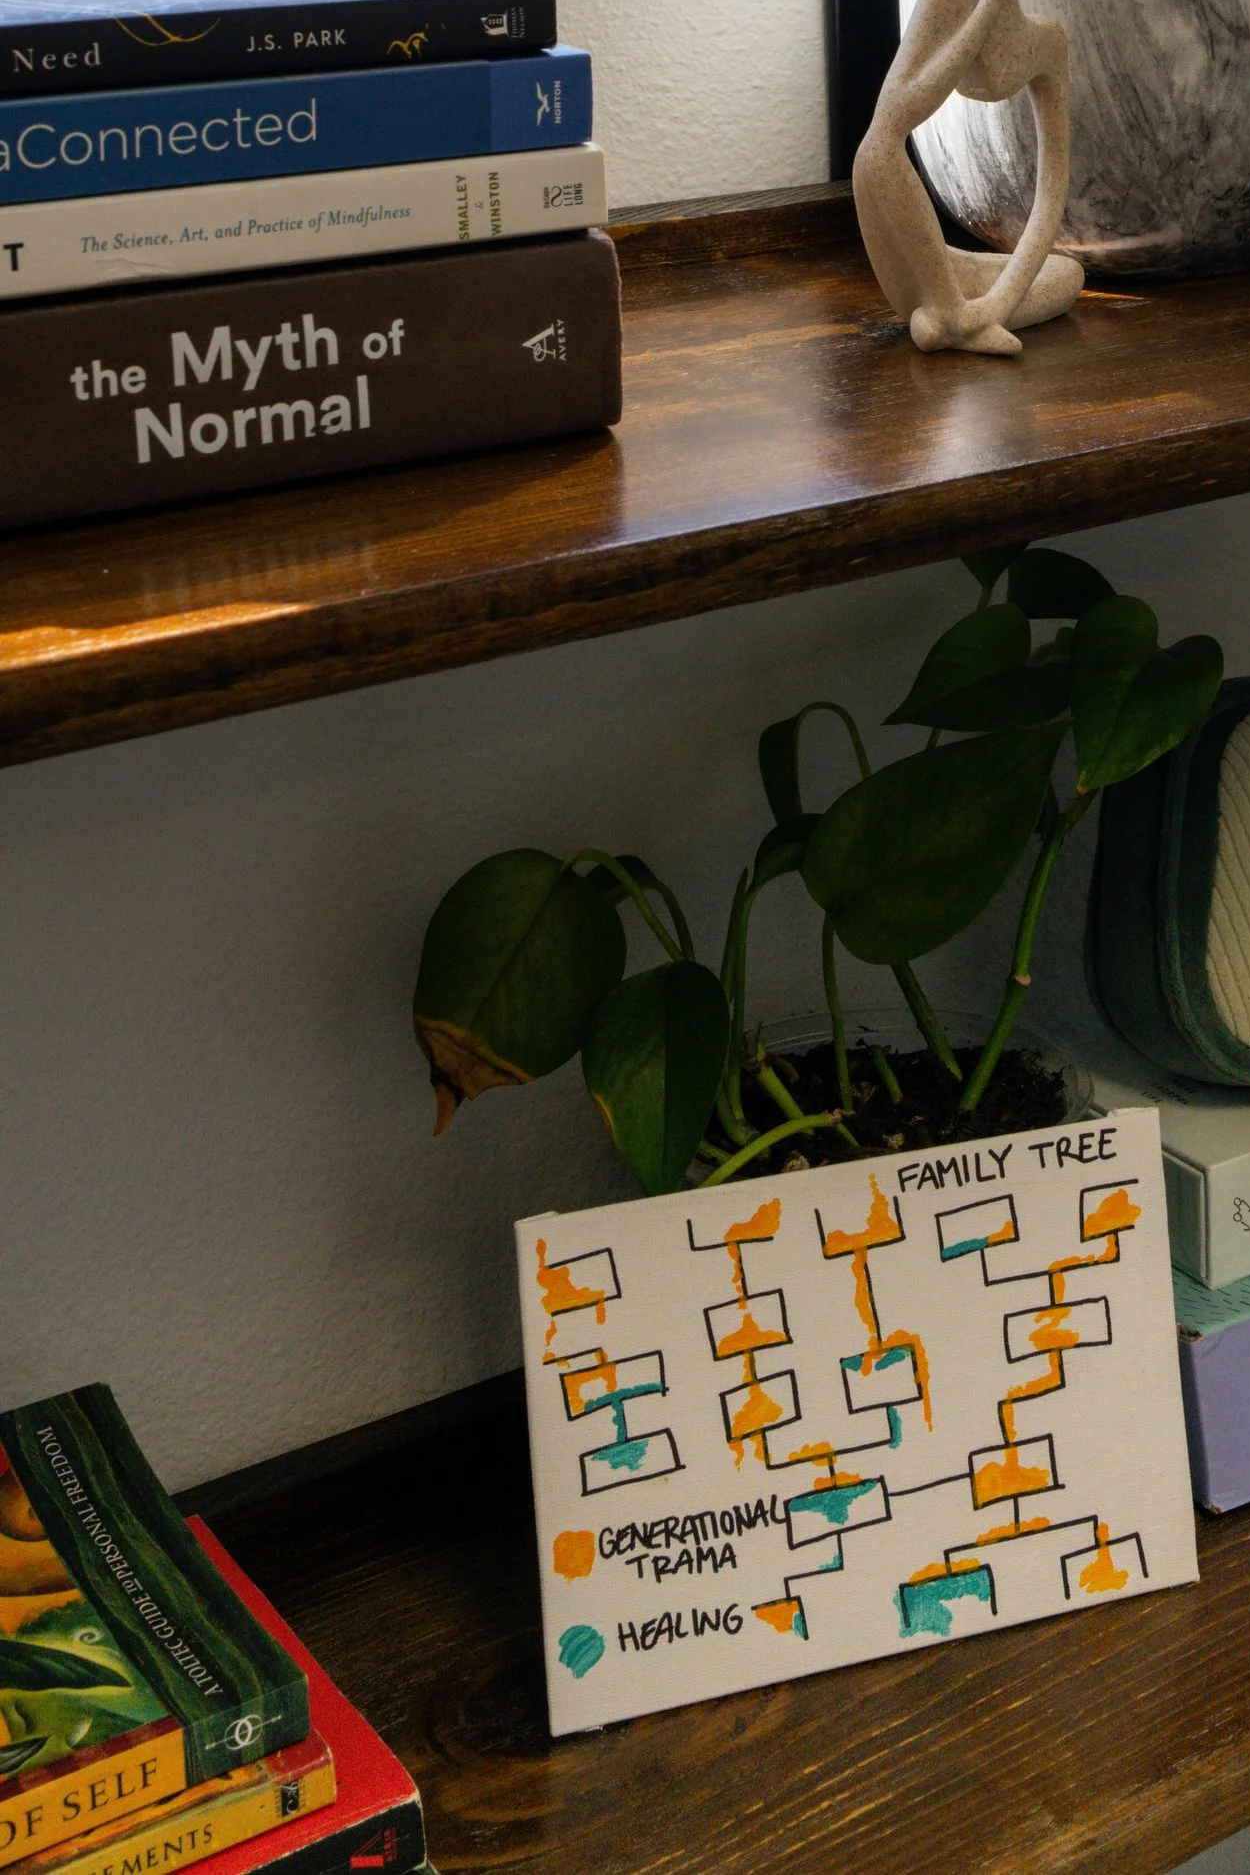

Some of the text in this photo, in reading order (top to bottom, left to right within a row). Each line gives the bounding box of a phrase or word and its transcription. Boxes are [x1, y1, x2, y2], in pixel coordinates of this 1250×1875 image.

[12, 28, 348, 74] Need J.S. PARK
[553, 80, 562, 124] NORTON
[456, 175, 470, 240] SMALLEY
[488, 172, 502, 237] WINSTON
[563, 184, 574, 207] LIFE
[573, 183, 584, 206] LONG
[80, 235, 108, 254] The
[113, 233, 173, 251] Science,
[179, 227, 208, 244] Art,
[214, 221, 242, 240] and
[247, 215, 304, 236] Practice
[308, 211, 326, 233] of
[327, 205, 412, 228] Mindfulness
[70, 312, 406, 402] the Myth of
[556, 319, 567, 362] AVERY
[134, 374, 372, 465] Normal
[898, 1127, 1118, 1193] FAMILY TREE
[37, 1427, 88, 1505] FREEDOM
[78, 1509, 131, 1581] PERSONAL
[599, 1494, 792, 1560] GENERATIONAL
[626, 1544, 737, 1583] TRAMA
[132, 1592, 175, 1641] GUIDE
[617, 1601, 744, 1652] HEALING
[164, 1636, 213, 1692] TOLTEC
[204, 1682, 224, 1696] A
[61, 1756, 159, 1822] SELF
